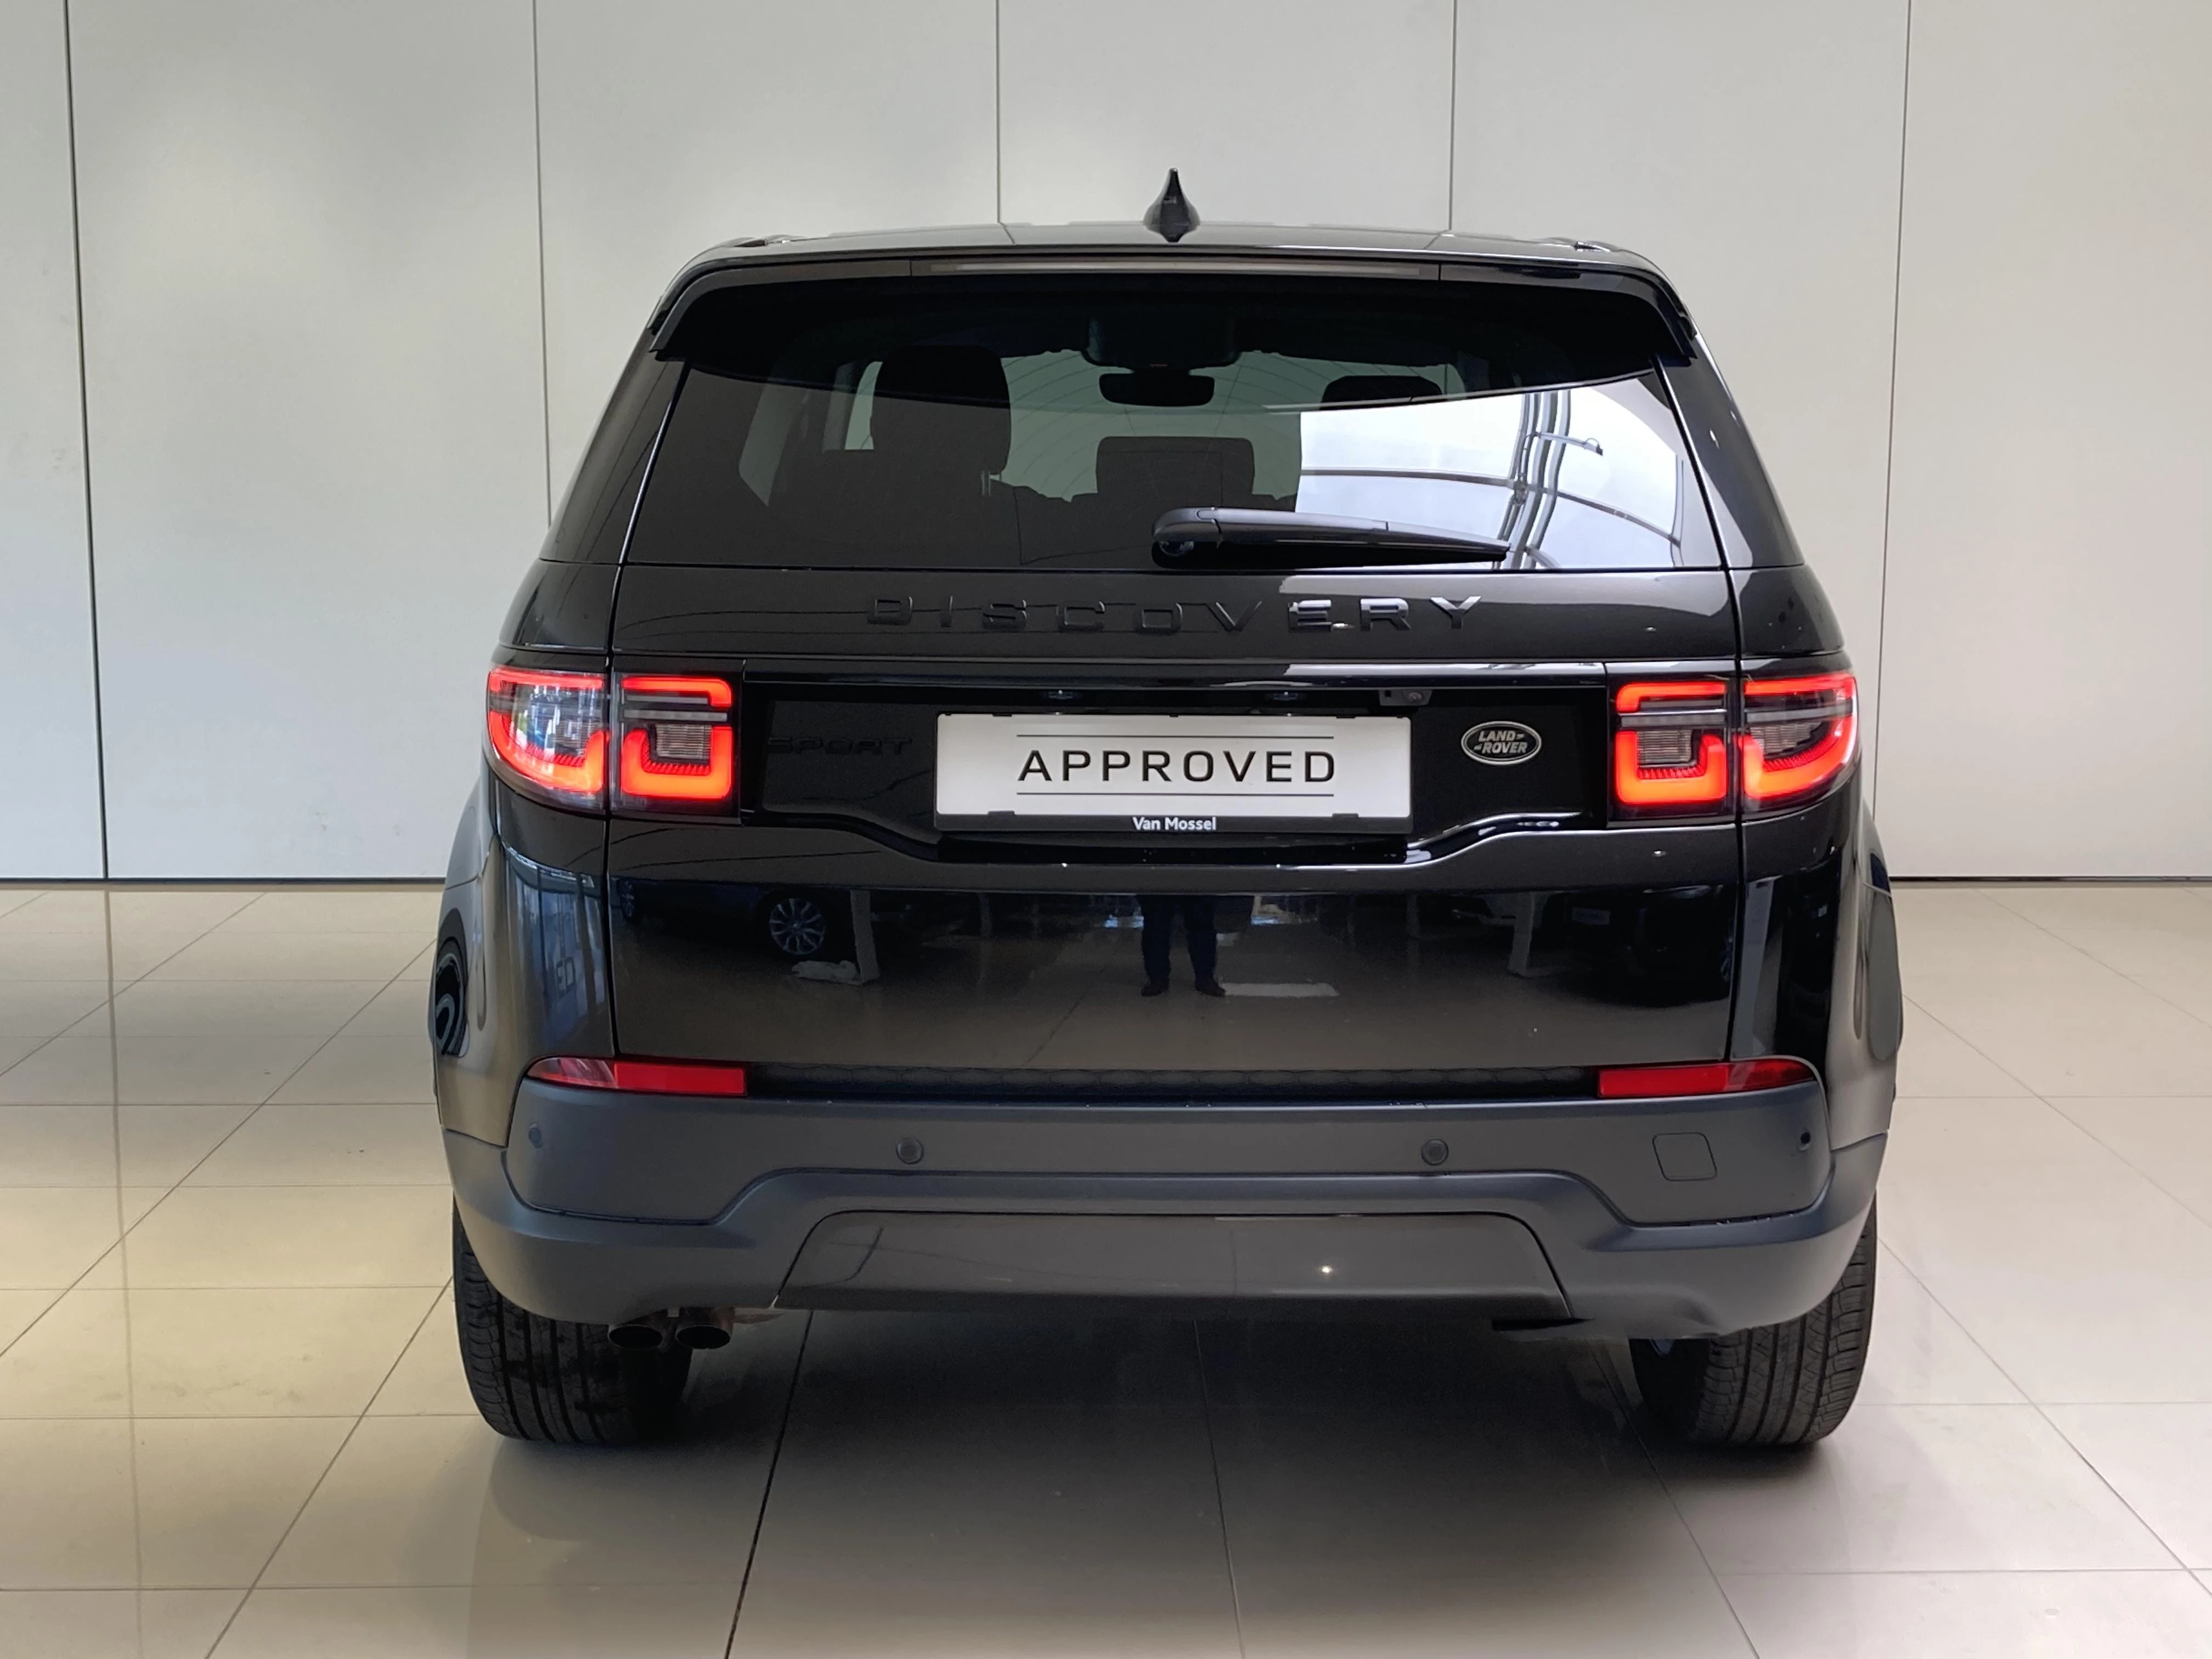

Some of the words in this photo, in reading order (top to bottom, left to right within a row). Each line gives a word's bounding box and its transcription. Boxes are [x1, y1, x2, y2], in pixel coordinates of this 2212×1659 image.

[867, 595, 1481, 633] DISCOVERY
[767, 737, 912, 755] SPORT
[1017, 749, 1335, 783] APPROVED
[1132, 816, 1161, 830] Van
[1165, 816, 1216, 830] Mossel
